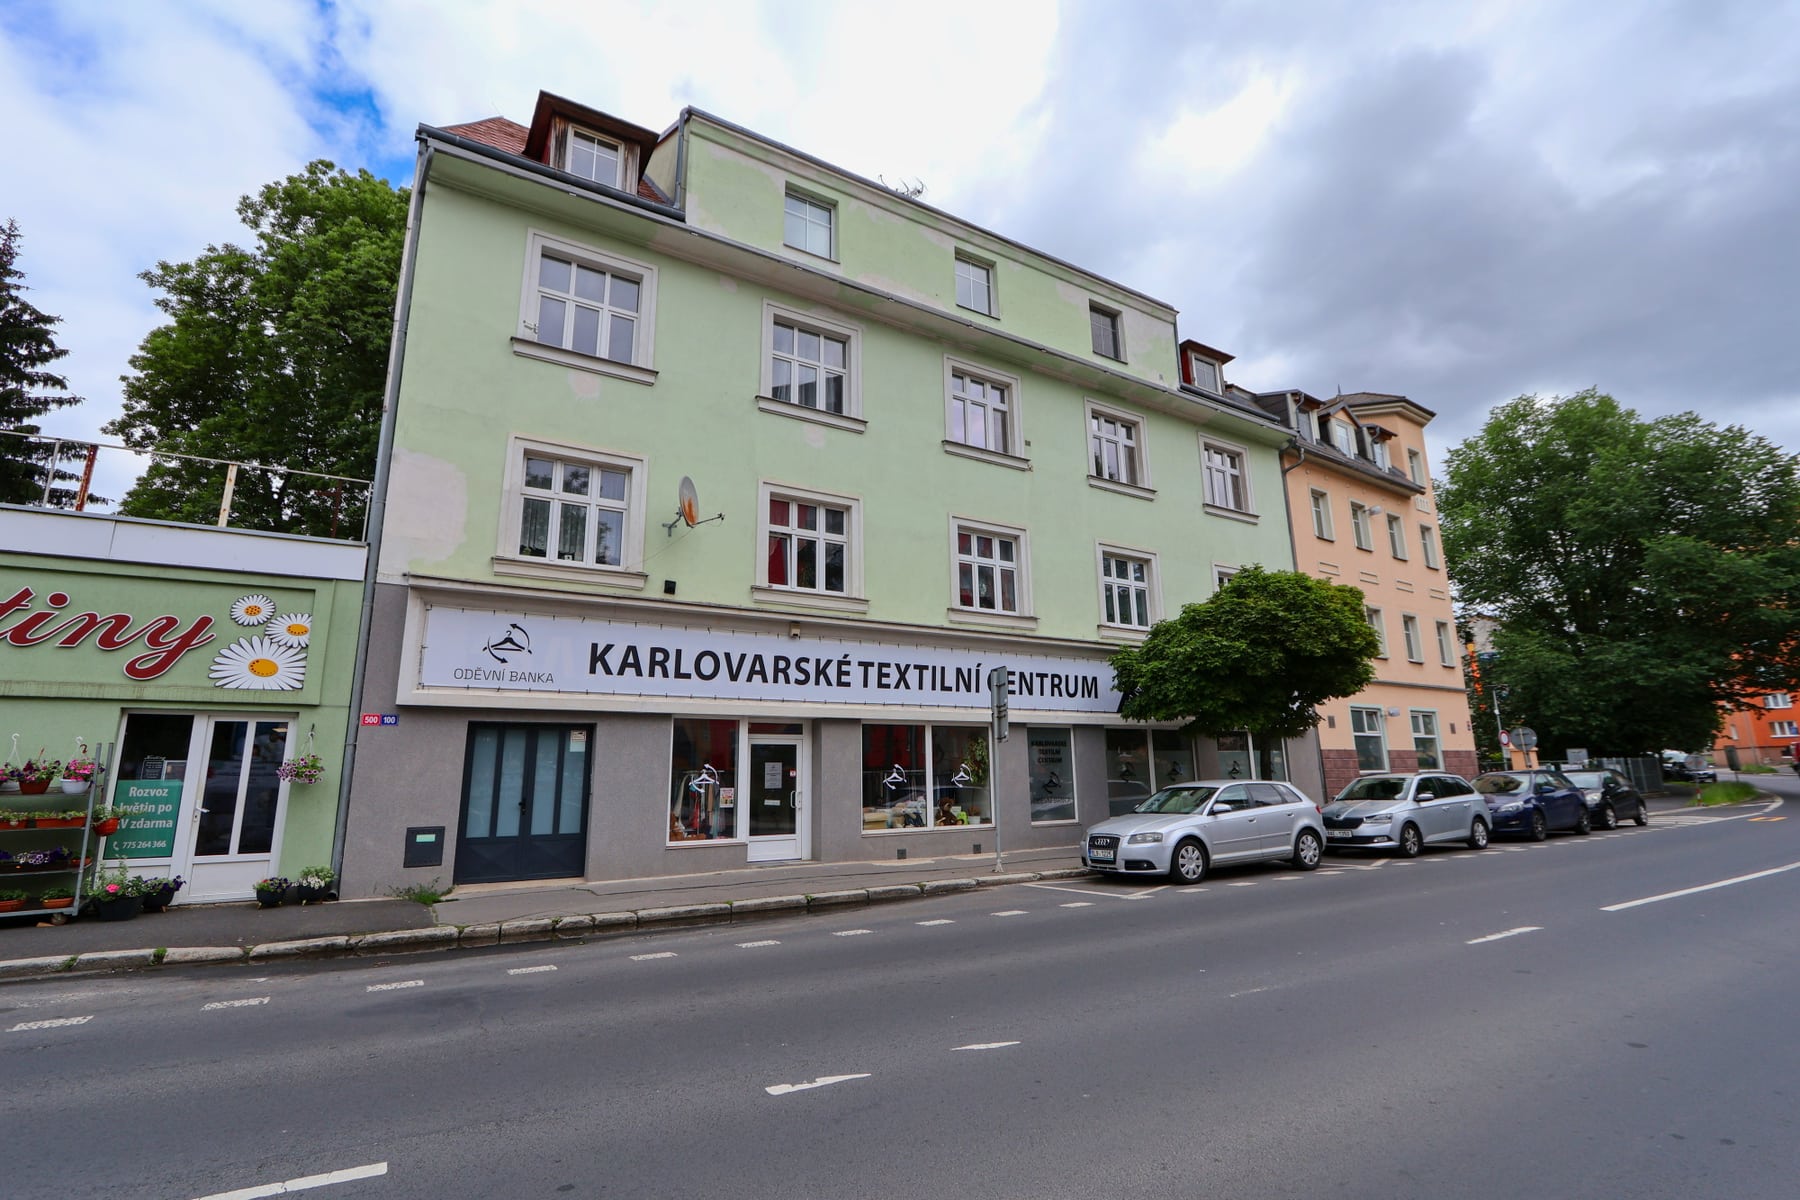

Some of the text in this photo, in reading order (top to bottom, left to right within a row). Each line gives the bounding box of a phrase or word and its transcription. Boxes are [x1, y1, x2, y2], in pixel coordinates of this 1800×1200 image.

[453, 666, 555, 684] ODĚVNÍ BANKA
[589, 642, 852, 689] KARLOVARSKÉ
[858, 660, 982, 694] TEXTILNÍ
[987, 669, 1100, 700] ENTRUM
[364, 715, 379, 724] 500
[383, 716, 396, 724] 100
[128, 786, 169, 797] Rozvoz
[157, 803, 173, 814] po
[130, 818, 173, 829] zdarma
